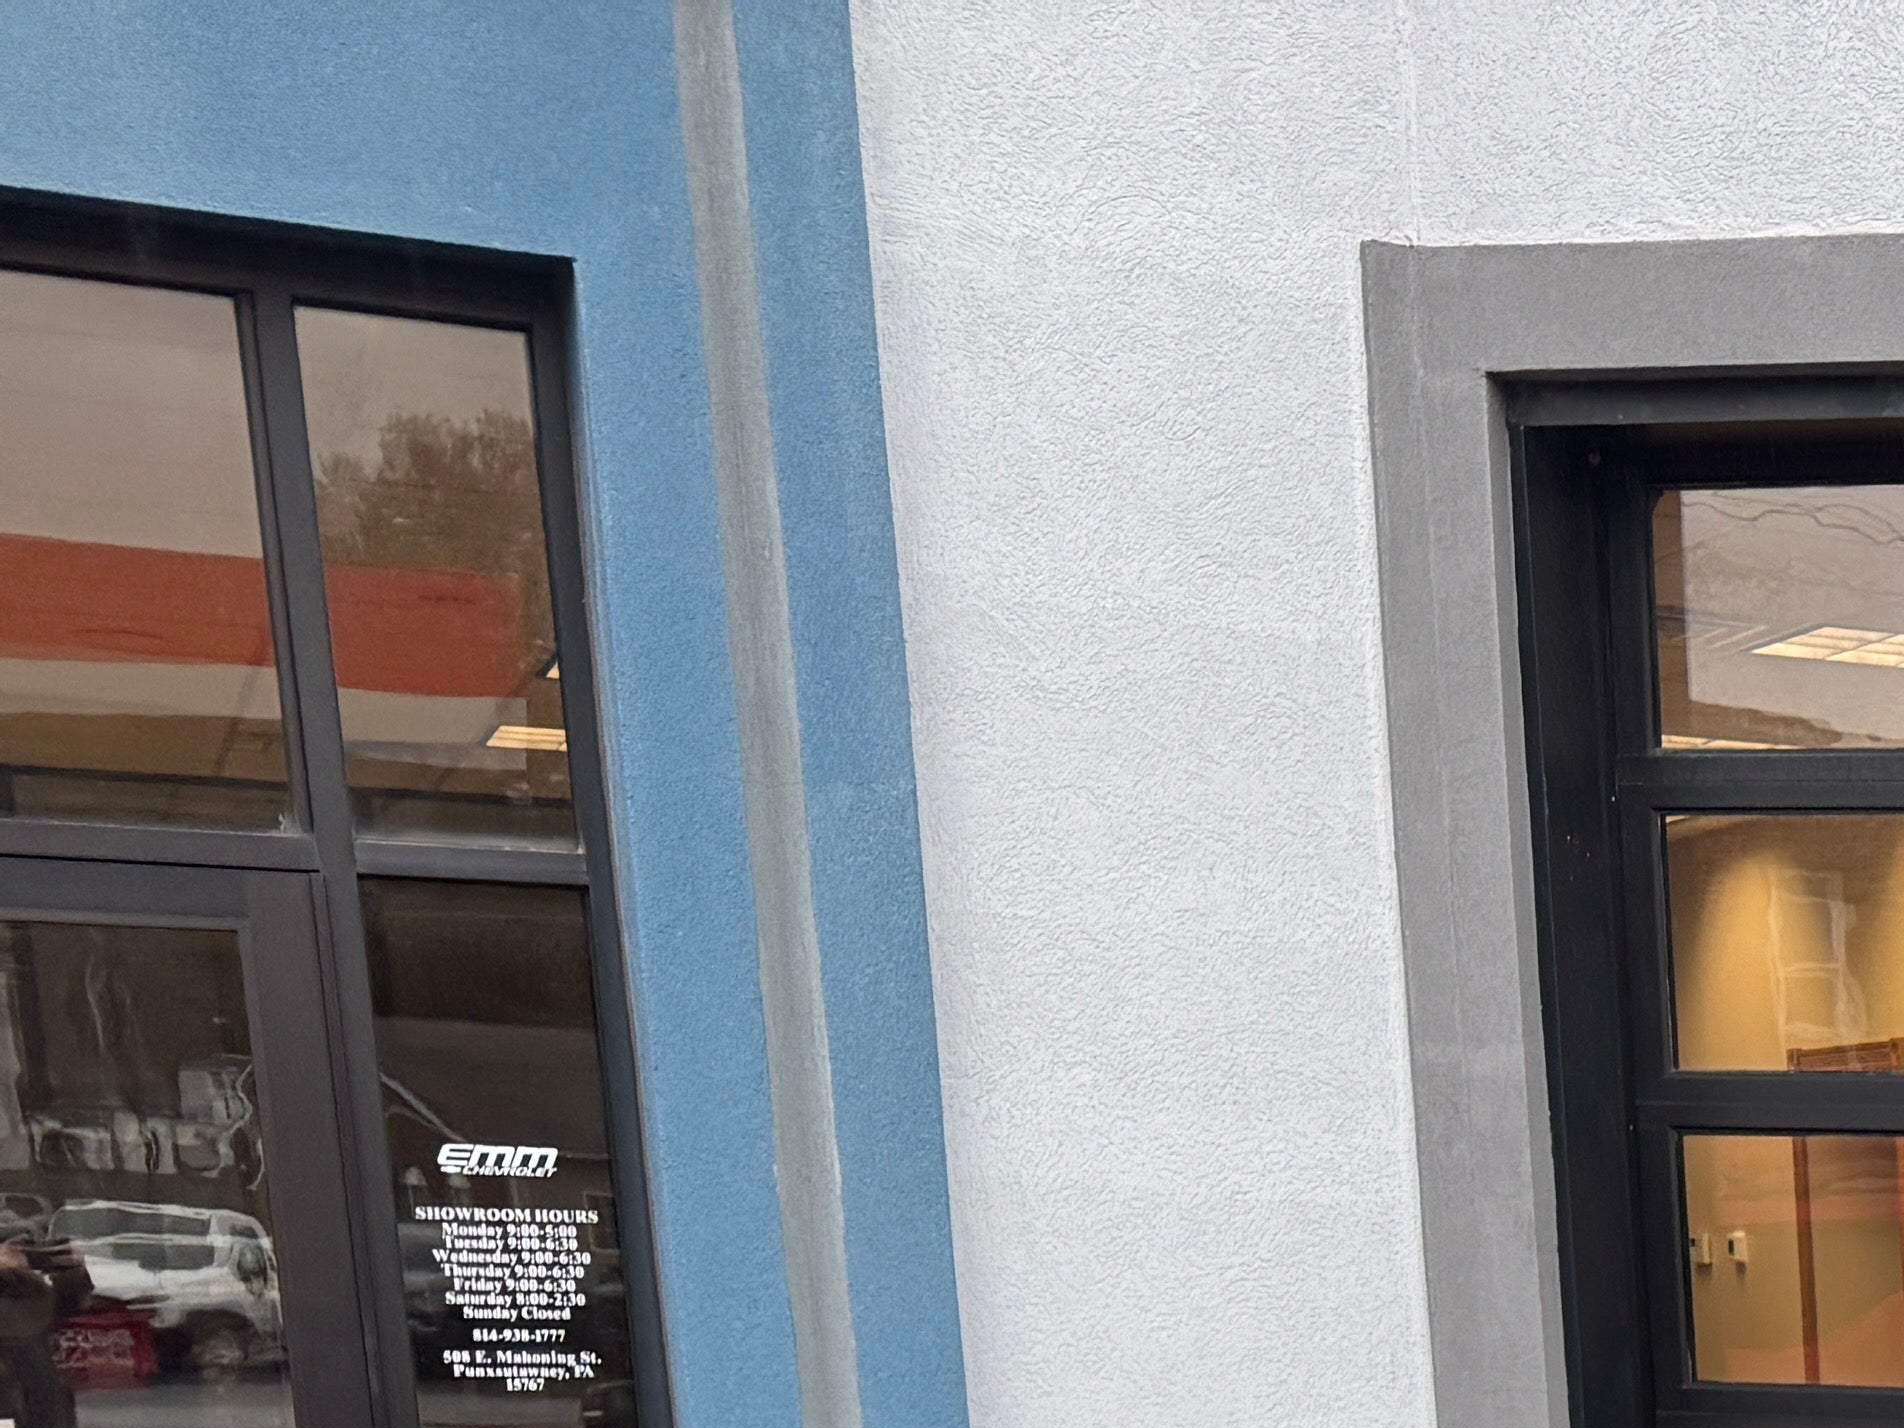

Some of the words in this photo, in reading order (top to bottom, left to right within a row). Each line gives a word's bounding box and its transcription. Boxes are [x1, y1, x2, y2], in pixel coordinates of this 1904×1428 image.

[415, 1206, 531, 1222] SHOWROOM
[535, 1208, 599, 1224] HOURS
[442, 1222, 503, 1238] Monday
[506, 1224, 577, 1238] 9:00-5:00
[443, 1237, 504, 1251] Tuesday
[507, 1237, 578, 1251] 9:00-6:30
[432, 1249, 518, 1266] Wednesday
[521, 1251, 592, 1265] 9:00-6:30
[441, 1263, 511, 1279] Thursday
[514, 1264, 585, 1278] 9:00-6:30
[453, 1278, 502, 1293] Friday
[506, 1279, 576, 1292] 9:00-6:30
[445, 1291, 512, 1308] Saturday
[463, 1306, 518, 1322] Sunday
[521, 1306, 571, 1320] Closed
[472, 1328, 566, 1342] 814-938-1777
[475, 1350, 492, 1364] E.
[496, 1350, 576, 1367] Mahoning
[580, 1351, 602, 1365] St.
[574, 1364, 594, 1378] PA
[506, 1378, 545, 1392] 15767
